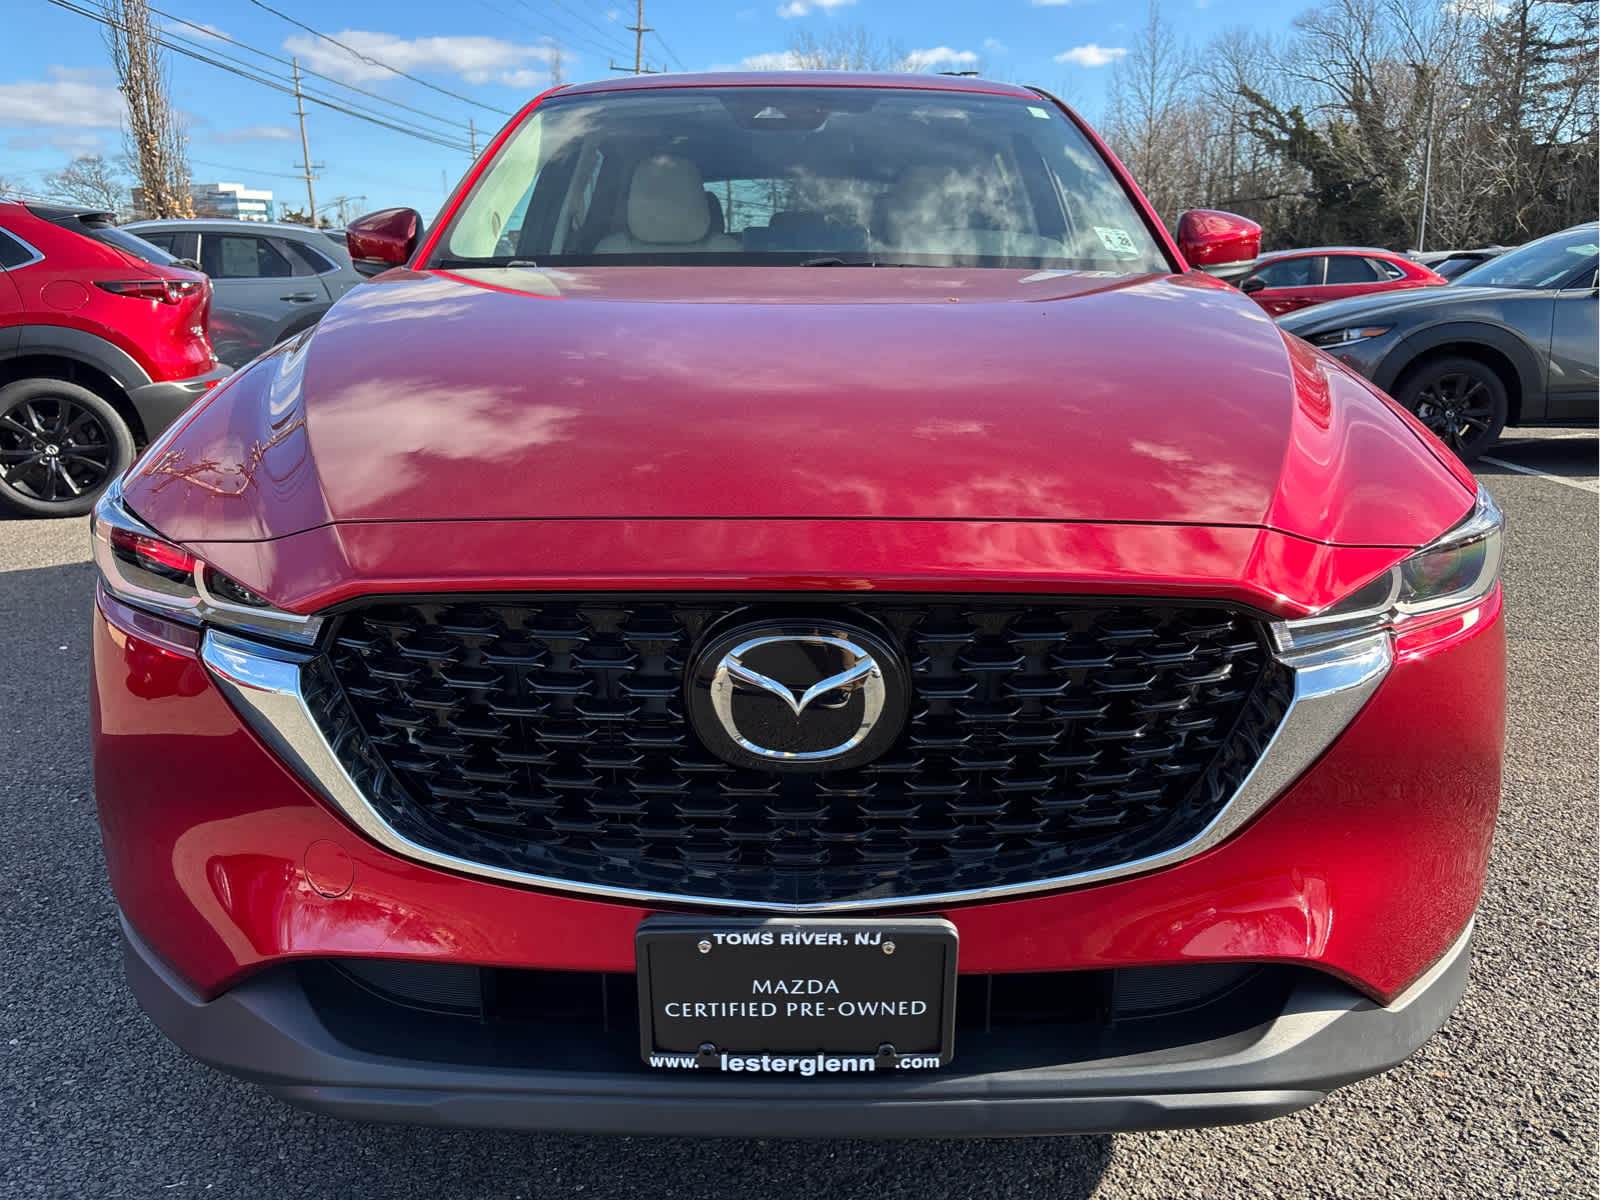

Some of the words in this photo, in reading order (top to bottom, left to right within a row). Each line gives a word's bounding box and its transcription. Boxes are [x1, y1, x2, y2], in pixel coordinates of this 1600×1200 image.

[712, 931, 774, 946] TOMS
[780, 931, 849, 947] RIVER,
[854, 931, 882, 946] NJ
[752, 979, 840, 994] MAZDA
[664, 1002, 777, 1018] CERTIFIED
[786, 1000, 927, 1017] PRE-OWNED
[649, 1056, 699, 1069] www.
[720, 1053, 876, 1076] lesterglenn
[894, 1056, 940, 1069] .com
